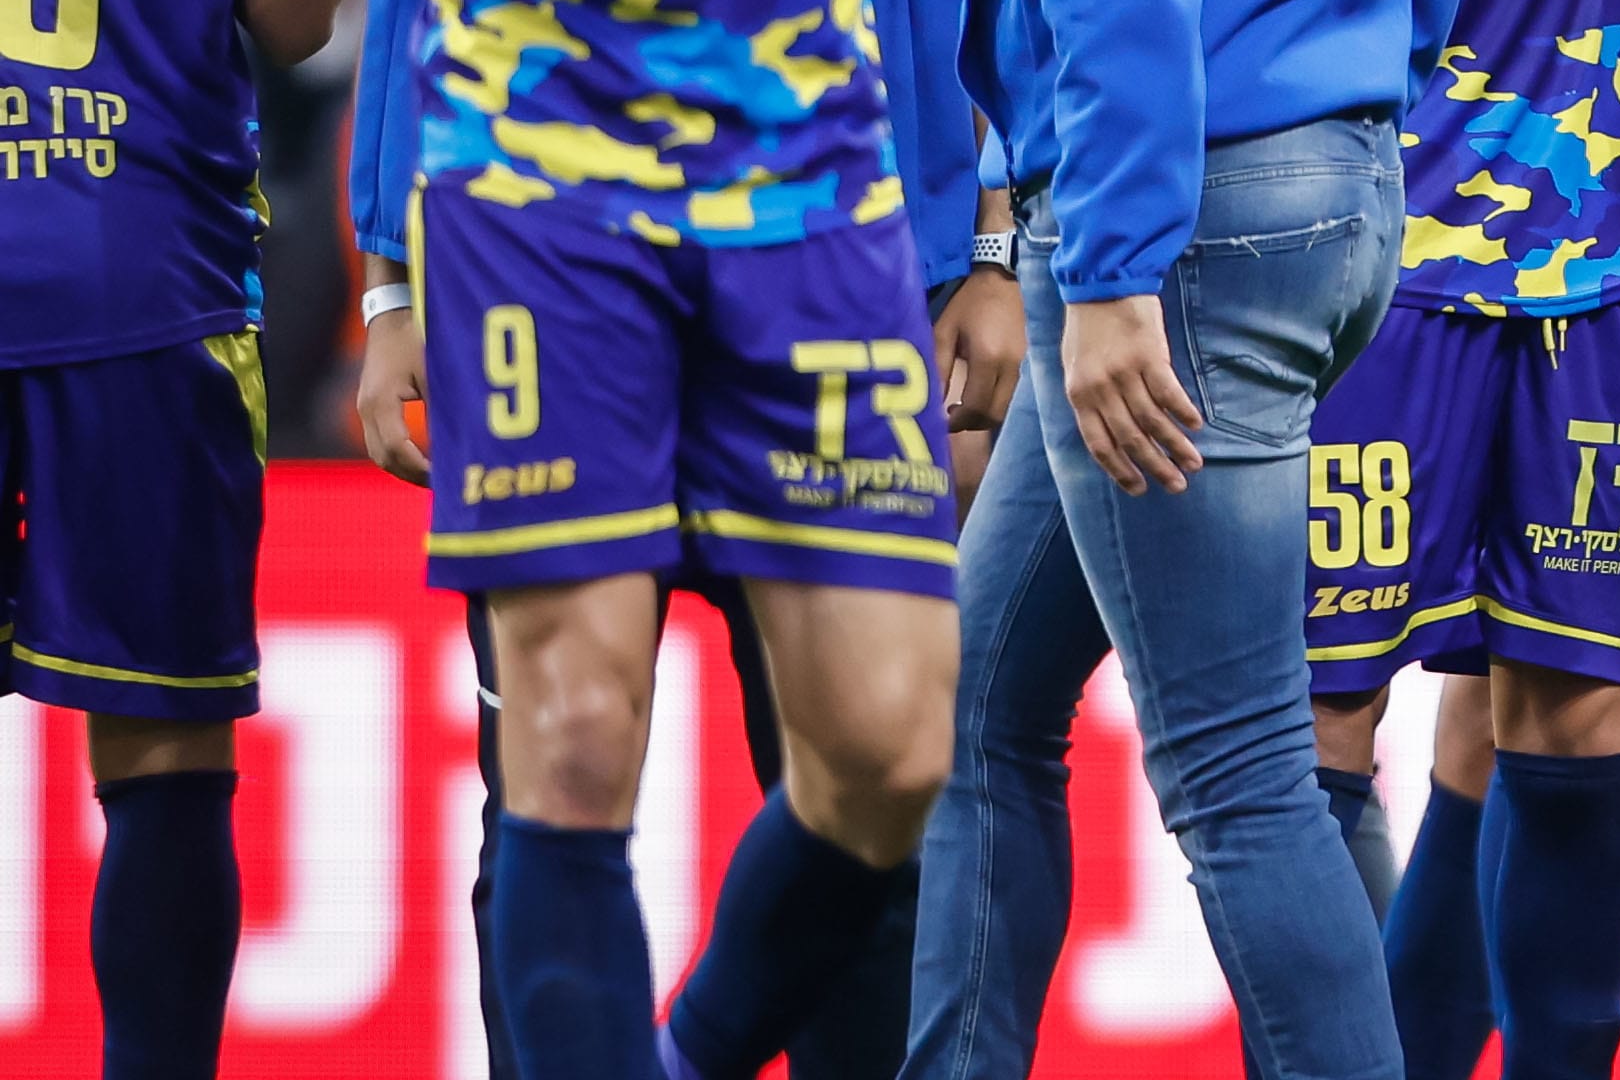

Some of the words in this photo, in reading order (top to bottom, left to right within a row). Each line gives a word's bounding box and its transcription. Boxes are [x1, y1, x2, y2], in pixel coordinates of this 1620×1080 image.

[50, 85, 128, 135] קרן
[484, 304, 540, 440] 9
[791, 339, 932, 463] TR
[1308, 441, 1411, 569] 58
[1308, 582, 1411, 618] Zeus
[1544, 556, 1579, 573] MAKE
[1580, 558, 1591, 573] IT
